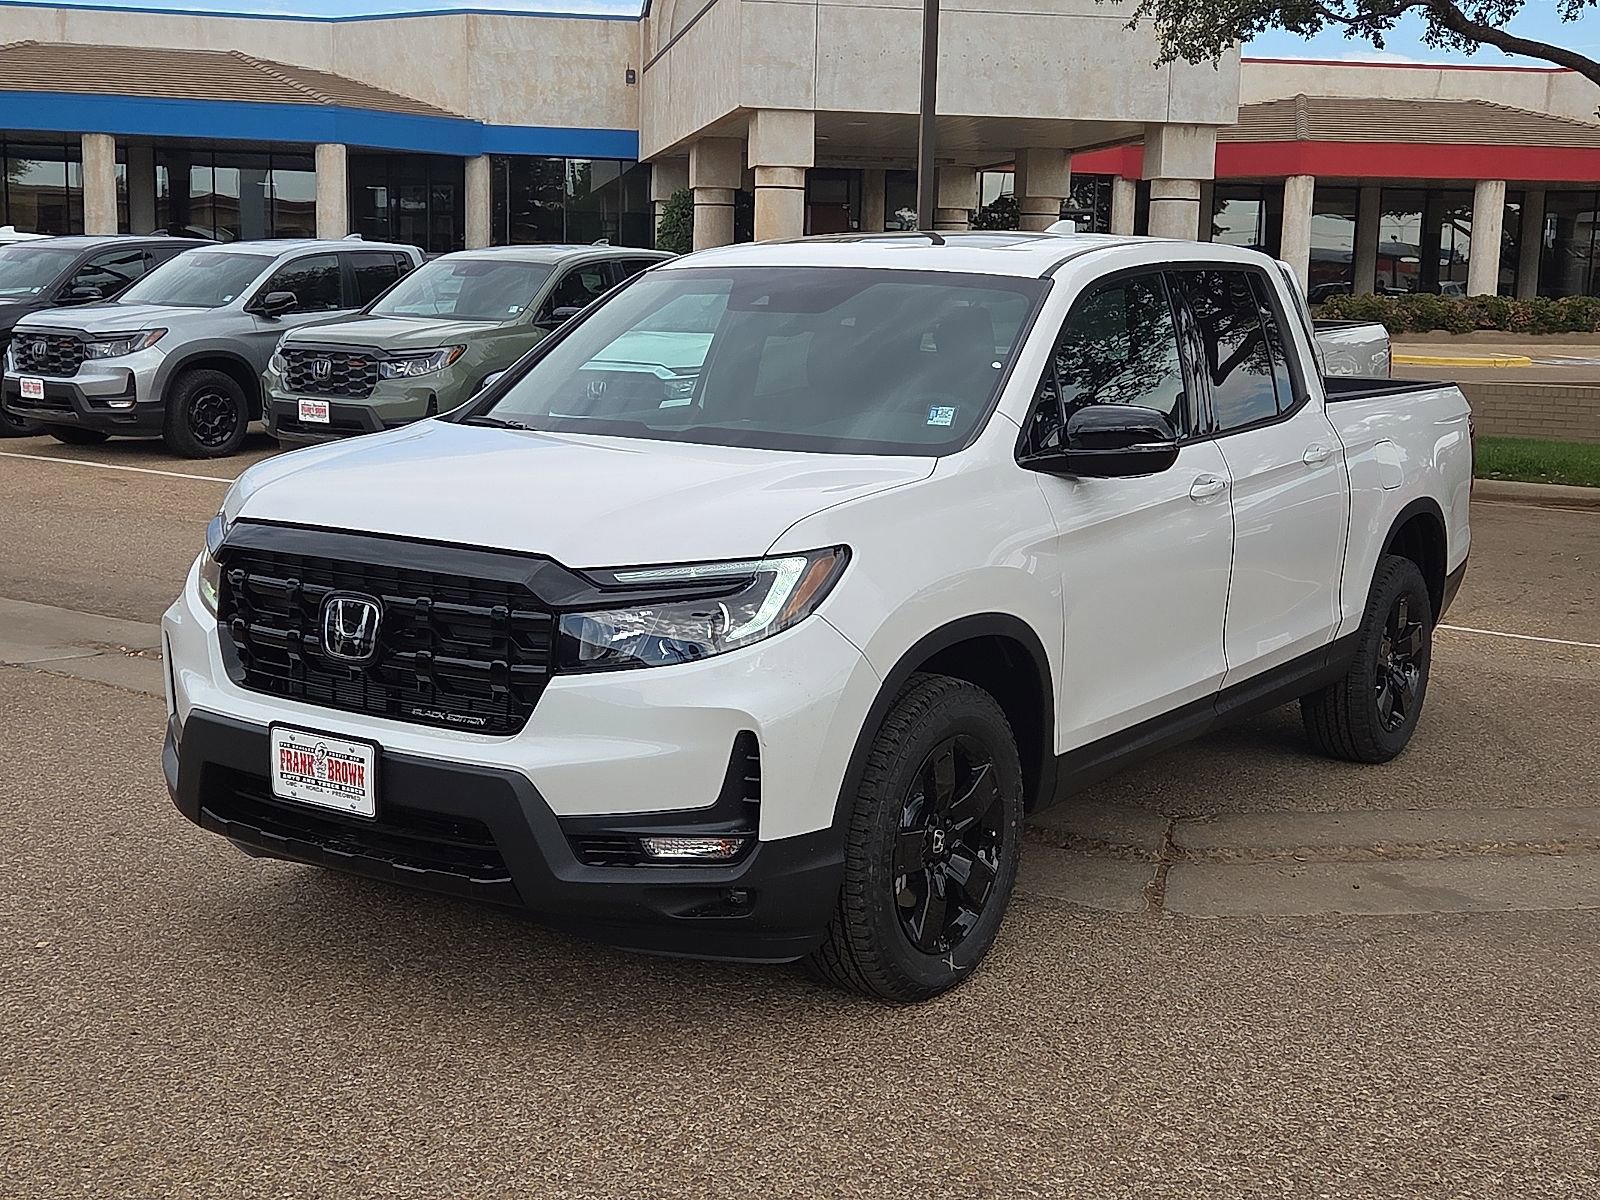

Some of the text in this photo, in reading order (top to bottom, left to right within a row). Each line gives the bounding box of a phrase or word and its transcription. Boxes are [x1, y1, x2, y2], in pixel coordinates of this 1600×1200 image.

[280, 749, 365, 788] FRANK BROWN
[282, 773, 364, 795] AUTO AND TRUCK RANCH
[305, 785, 324, 793] HONDA
[331, 790, 361, 802] PREOWNED
